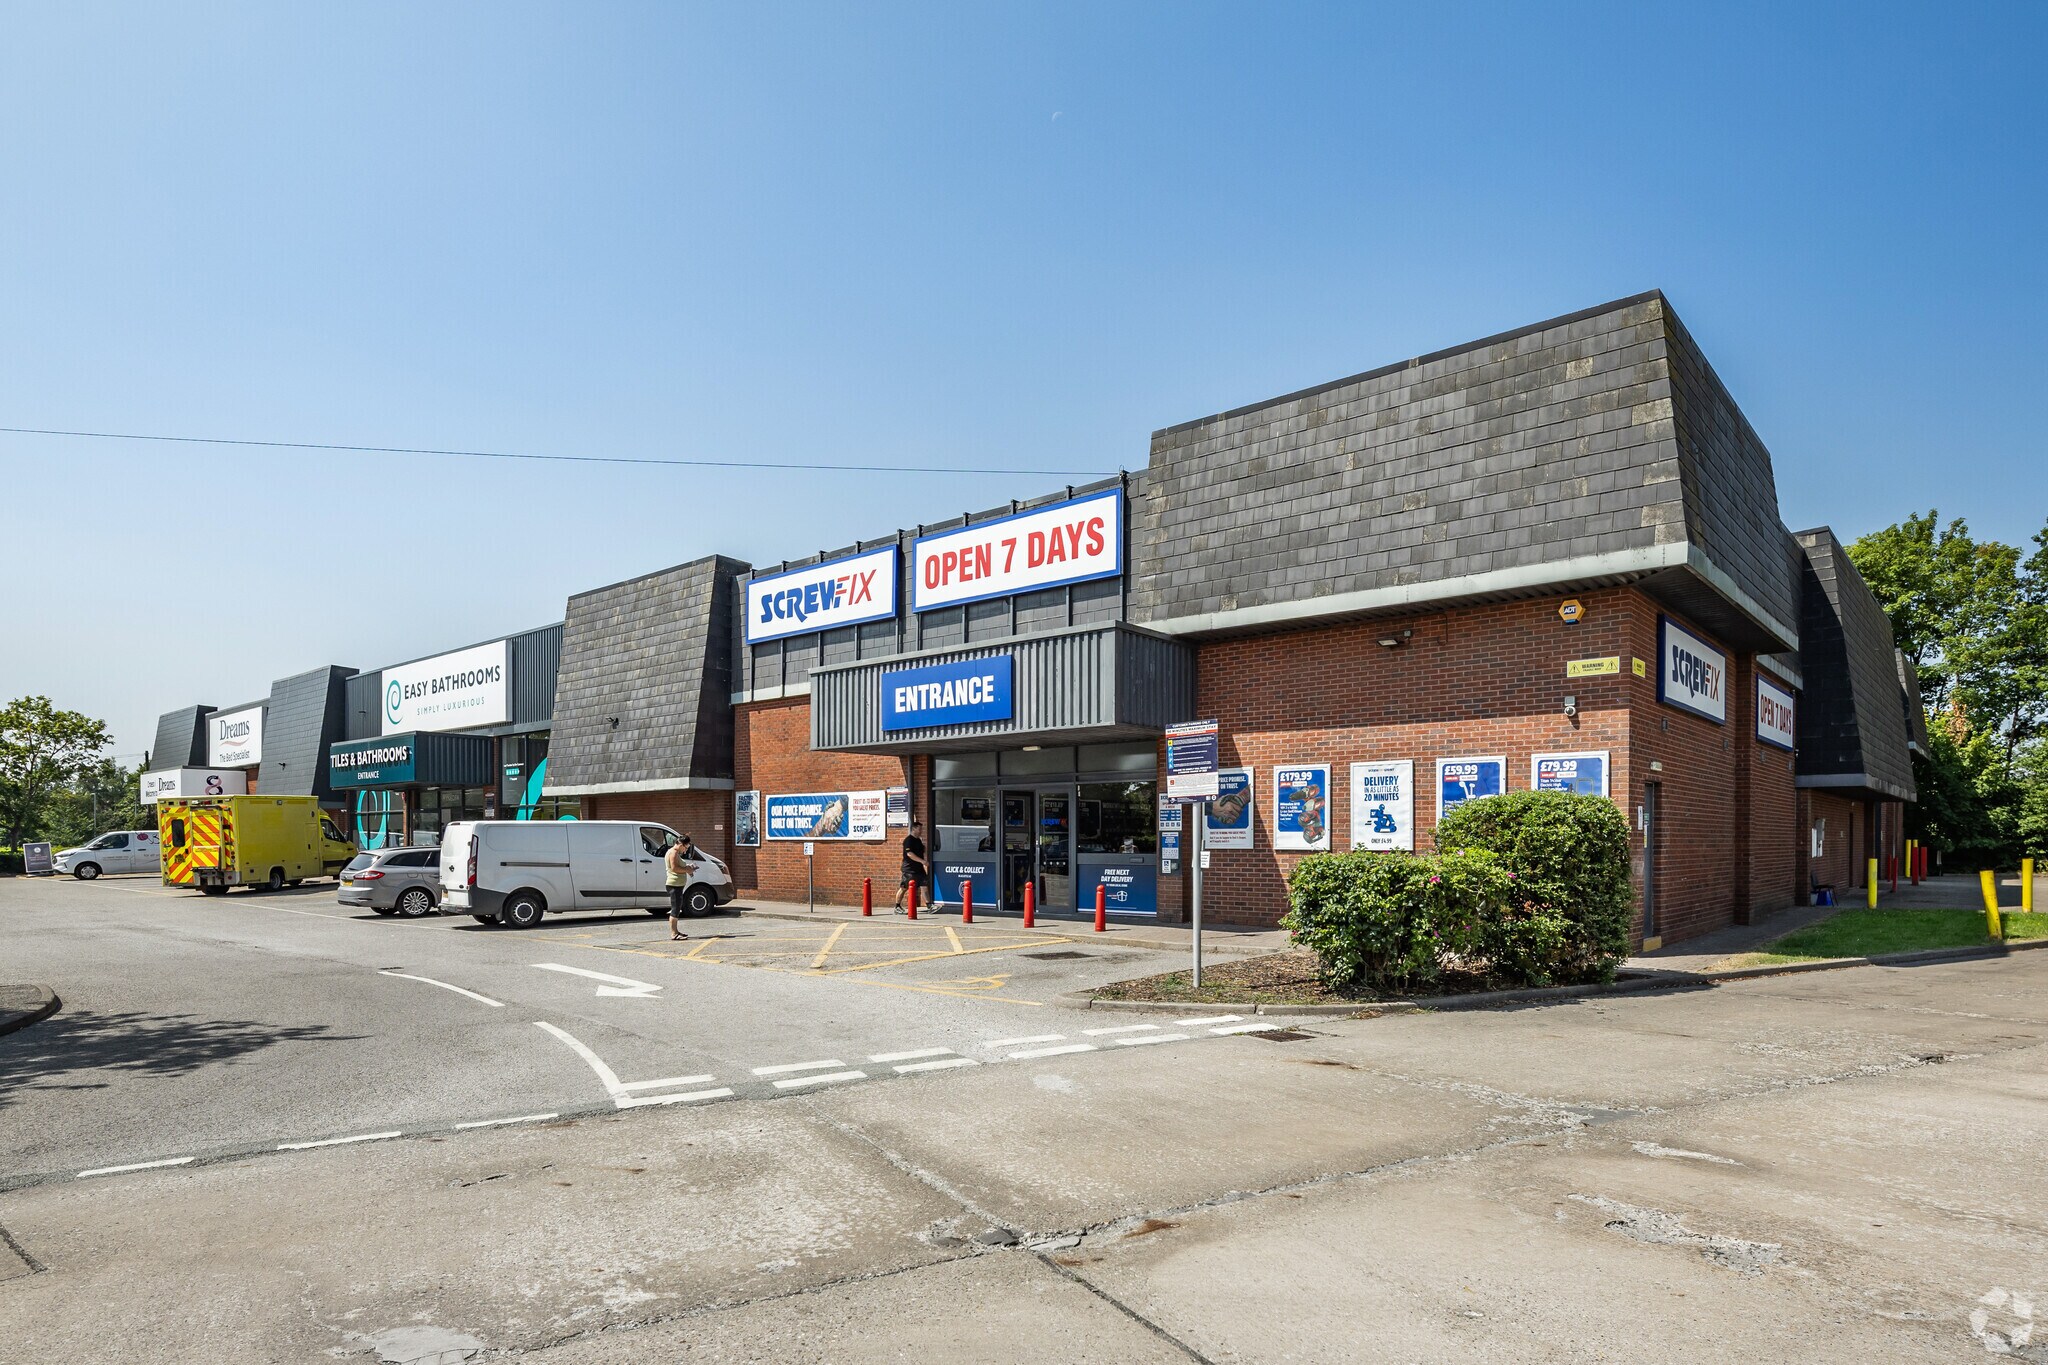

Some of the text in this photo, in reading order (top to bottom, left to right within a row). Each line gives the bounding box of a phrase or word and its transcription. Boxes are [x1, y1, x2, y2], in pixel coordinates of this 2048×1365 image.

[925, 517, 1104, 589] OPEN 7 DAYS
[760, 569, 876, 623] SCREWFIX
[1672, 644, 1720, 702] SCREWFIX
[404, 665, 500, 700] EASY BATHROOMS
[894, 674, 995, 714] ENTRANCE
[416, 696, 485, 716] SIMPLY LUXURIOUS
[1760, 694, 1792, 735] OPEN 7 DAYS
[220, 720, 250, 740] Dreams
[330, 746, 407, 768] TILES & BATHROOMS
[1444, 764, 1478, 775] £59.99
[1540, 760, 1577, 771] £79.99
[358, 771, 379, 780] ENTRANCE
[1280, 771, 1313, 782] £179.99
[1364, 776, 1399, 786] DELIVERY
[158, 778, 176, 792] Dreams
[1374, 793, 1399, 801] MINUTES
[771, 804, 824, 816] OUR PRICE PROMISE.
[771, 817, 813, 828] BUILT ON TRUST.
[853, 824, 880, 834] SCREWFIX
